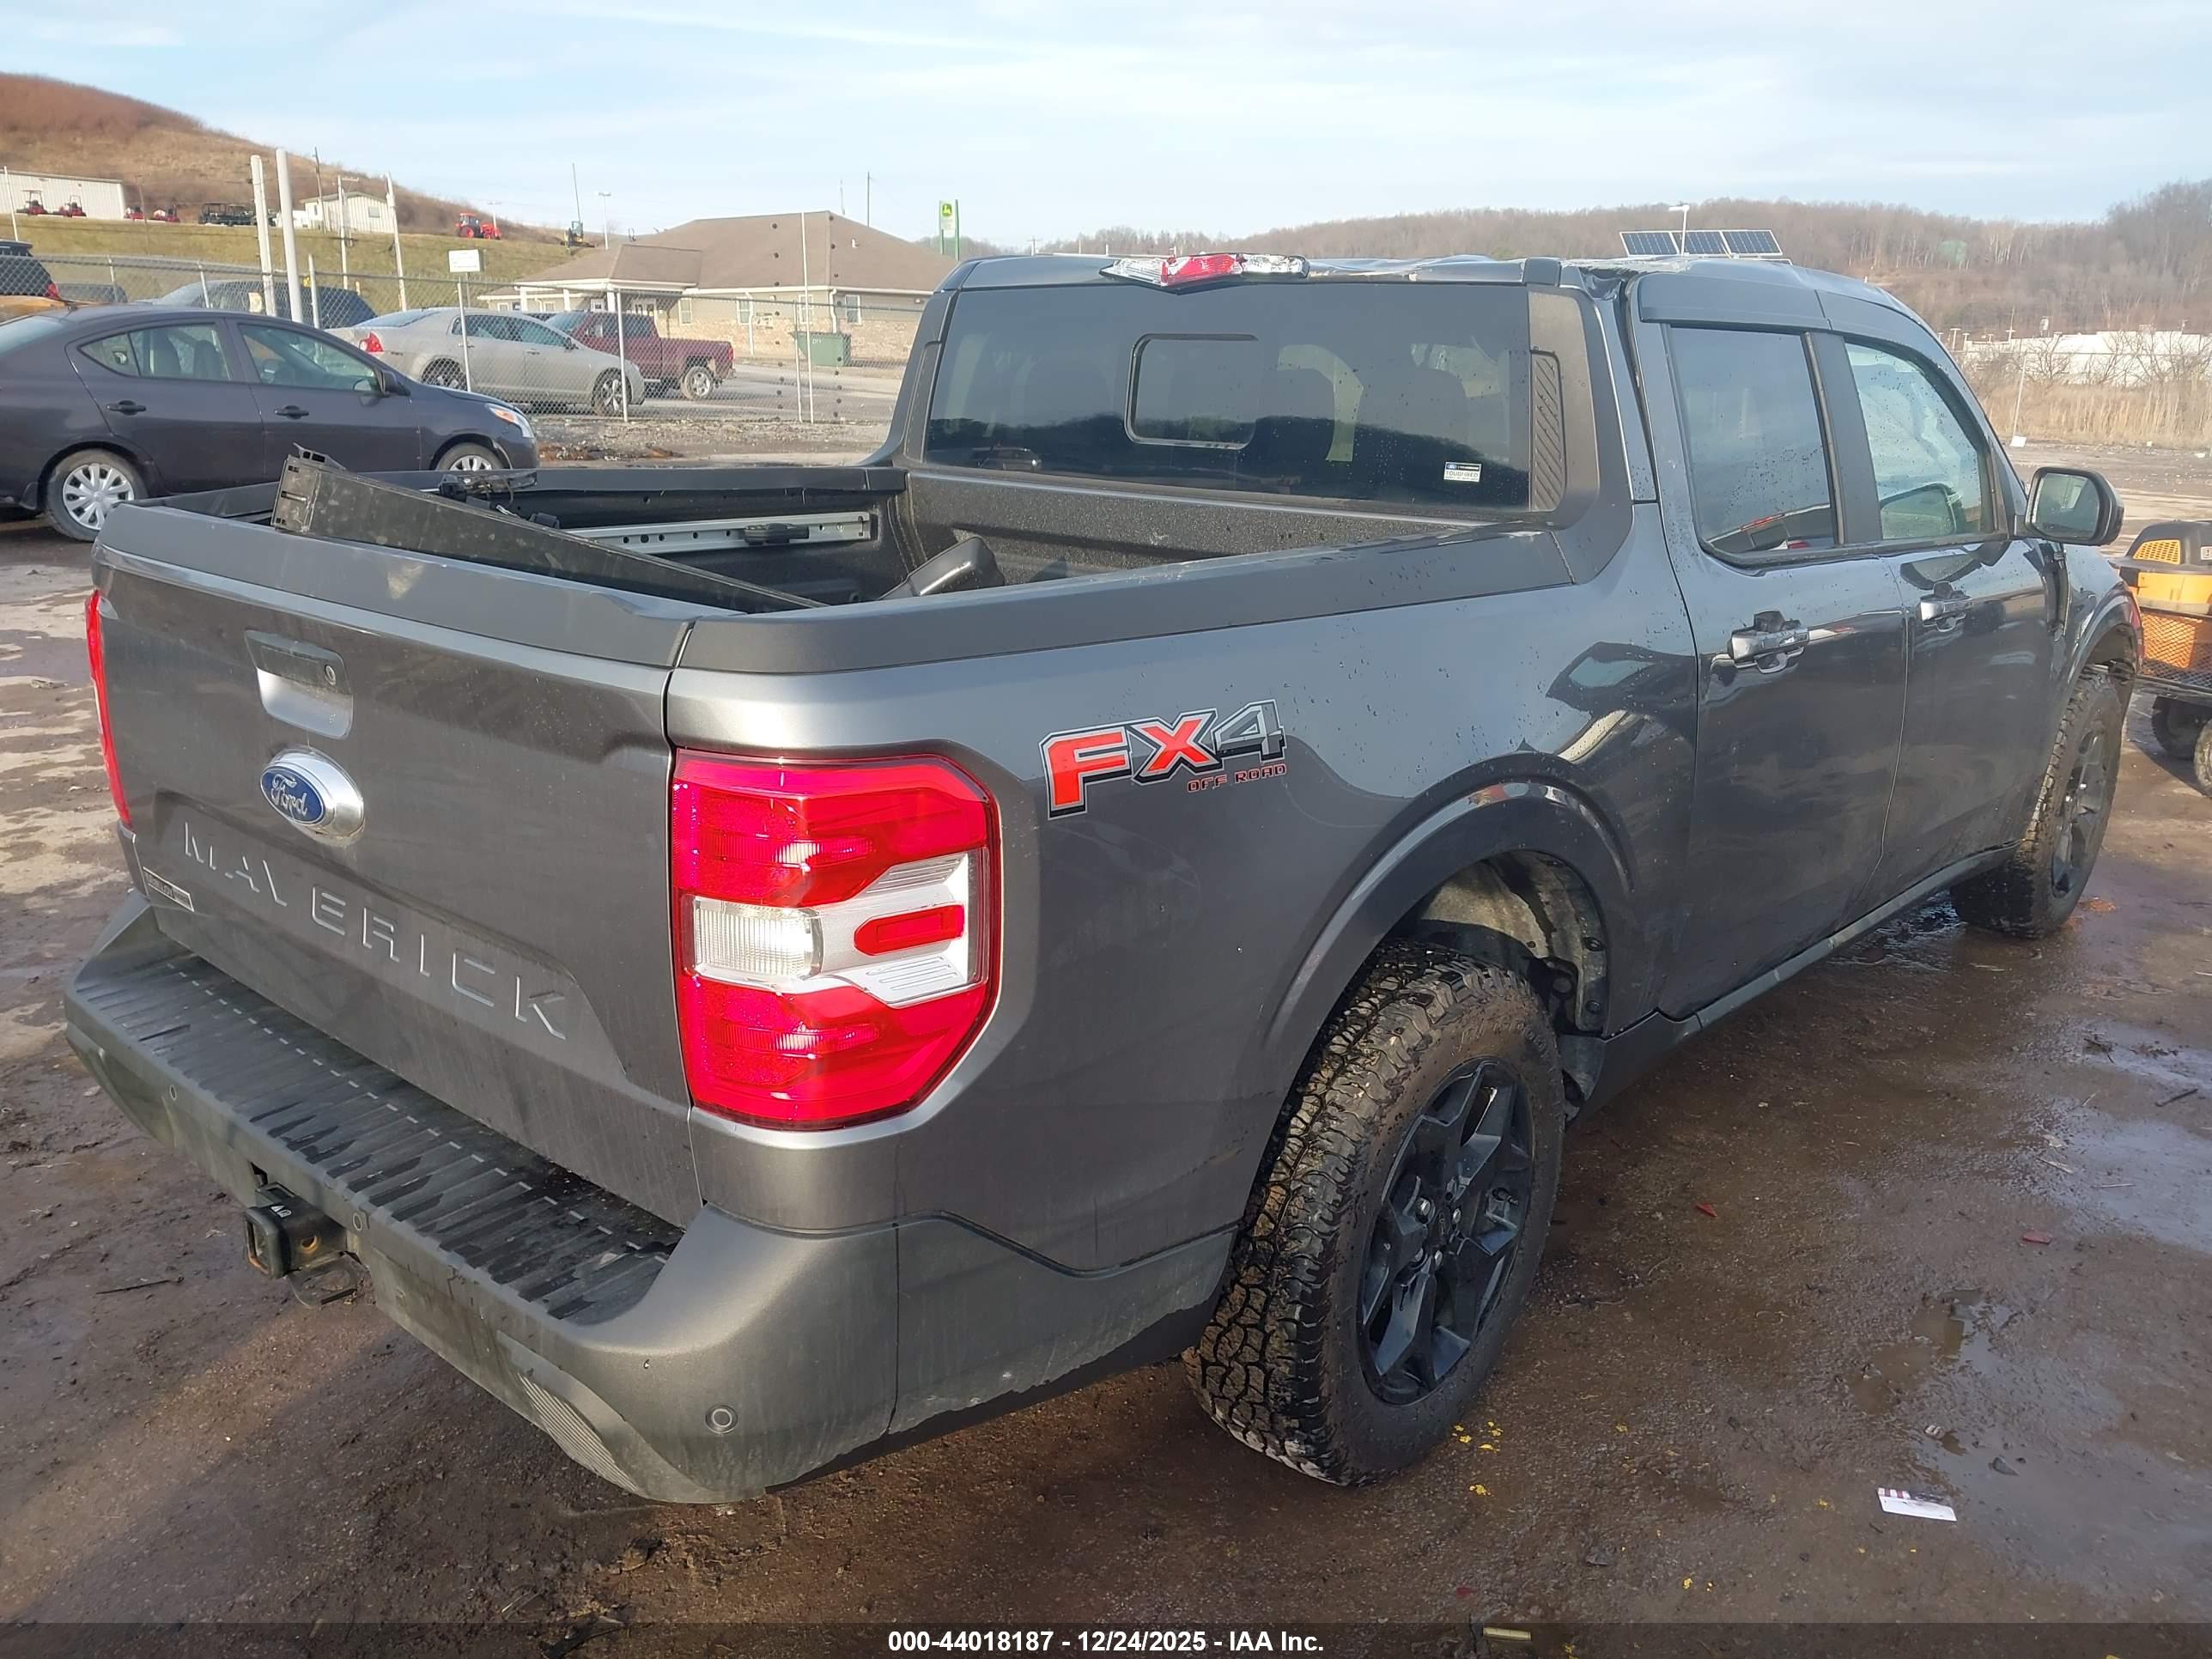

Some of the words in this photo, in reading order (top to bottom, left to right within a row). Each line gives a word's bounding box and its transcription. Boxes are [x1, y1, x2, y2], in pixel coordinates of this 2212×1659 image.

[270, 774, 307, 817] Ford
[1038, 698, 1286, 821] FX4
[1188, 775, 1228, 793] OFF
[1235, 763, 1287, 783] ROAD
[183, 822, 568, 1041] MAVERICK
